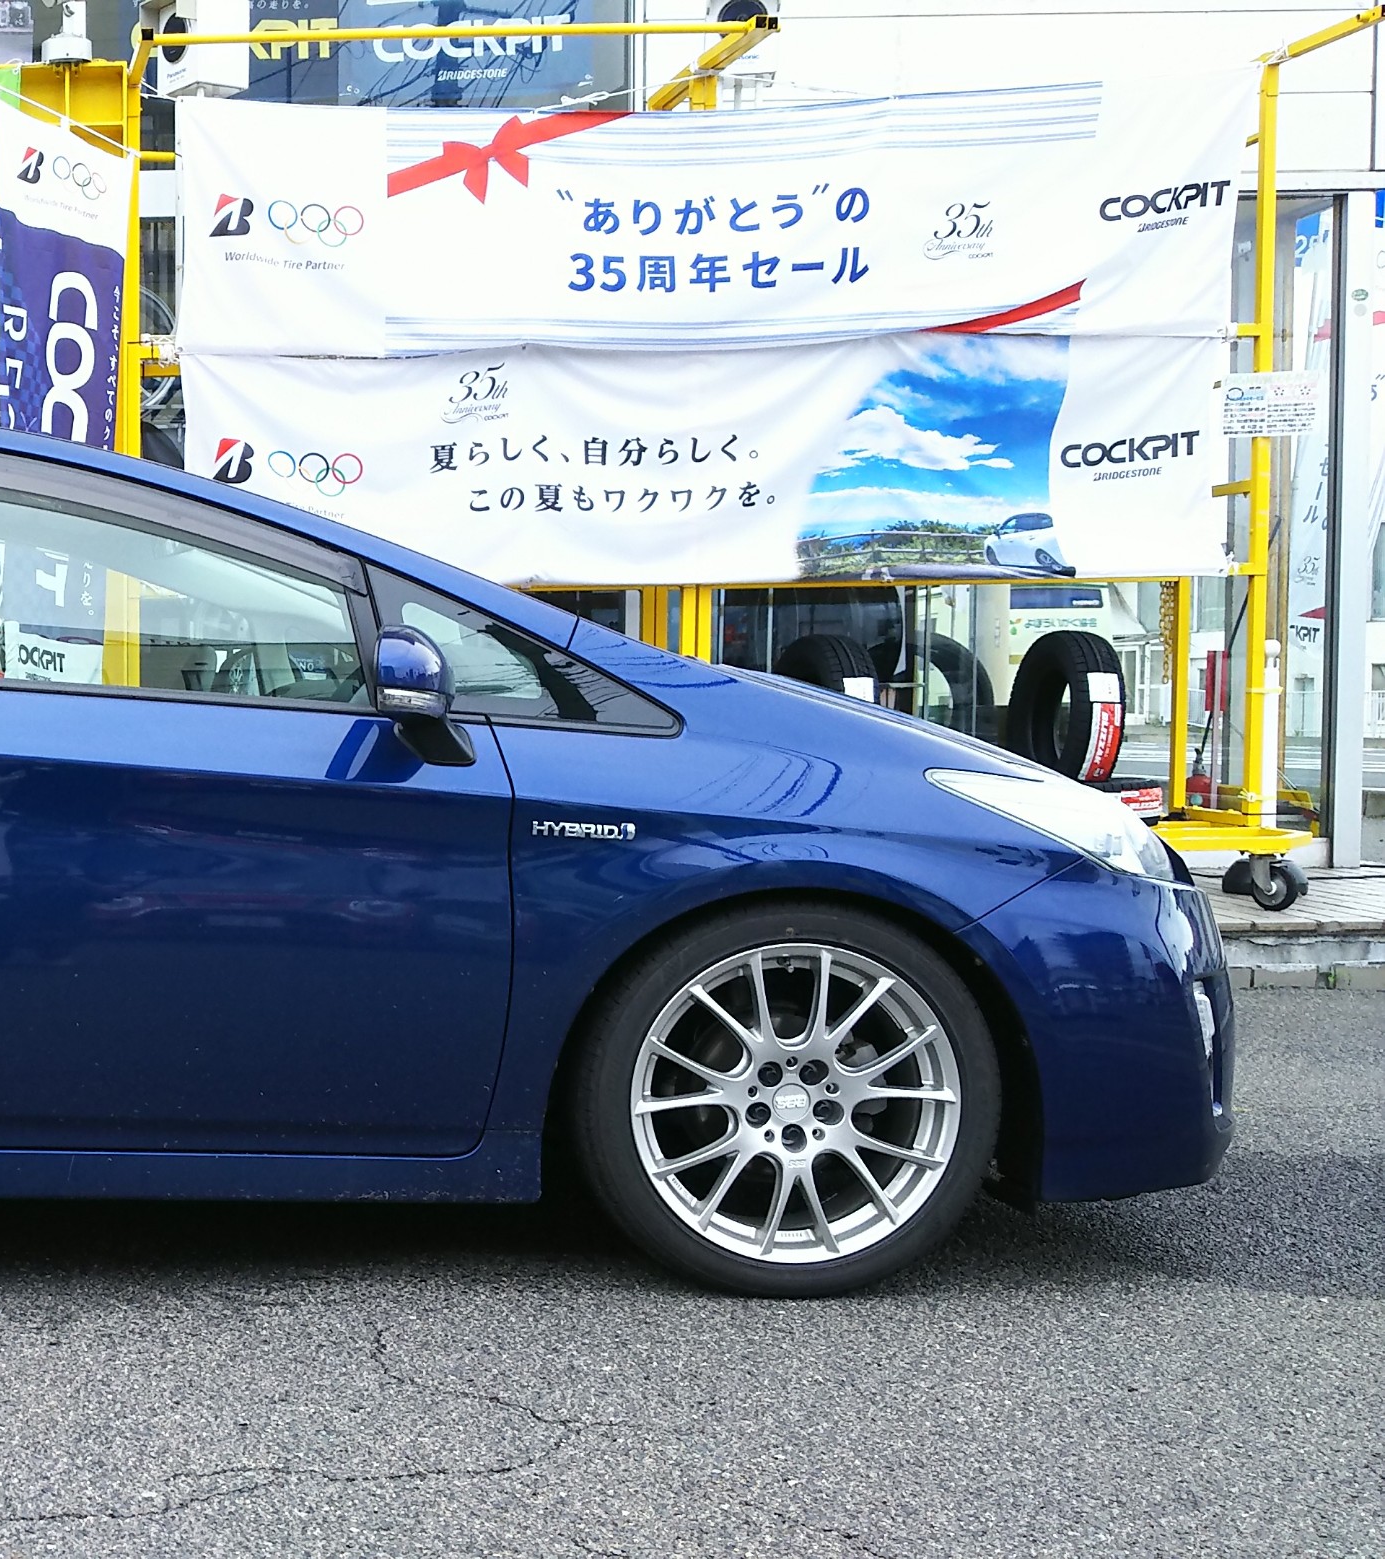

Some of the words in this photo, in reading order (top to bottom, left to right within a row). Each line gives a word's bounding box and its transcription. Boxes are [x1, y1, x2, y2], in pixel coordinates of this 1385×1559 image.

[373, 14, 571, 62] COCKPIT
[1099, 180, 1231, 222] COCKPIT
[224, 251, 280, 267] Worldwide
[283, 259, 303, 270] Tire
[305, 260, 346, 271] Partner
[567, 246, 870, 293] 35周年セール
[429, 434, 760, 474] 夏らしく、自分らしく。
[1060, 430, 1201, 469] COCKPIT
[1092, 466, 1163, 481] BRIDGESTONE
[468, 481, 776, 514] この夏もワクワクを。
[532, 821, 619, 840] HYBRID
